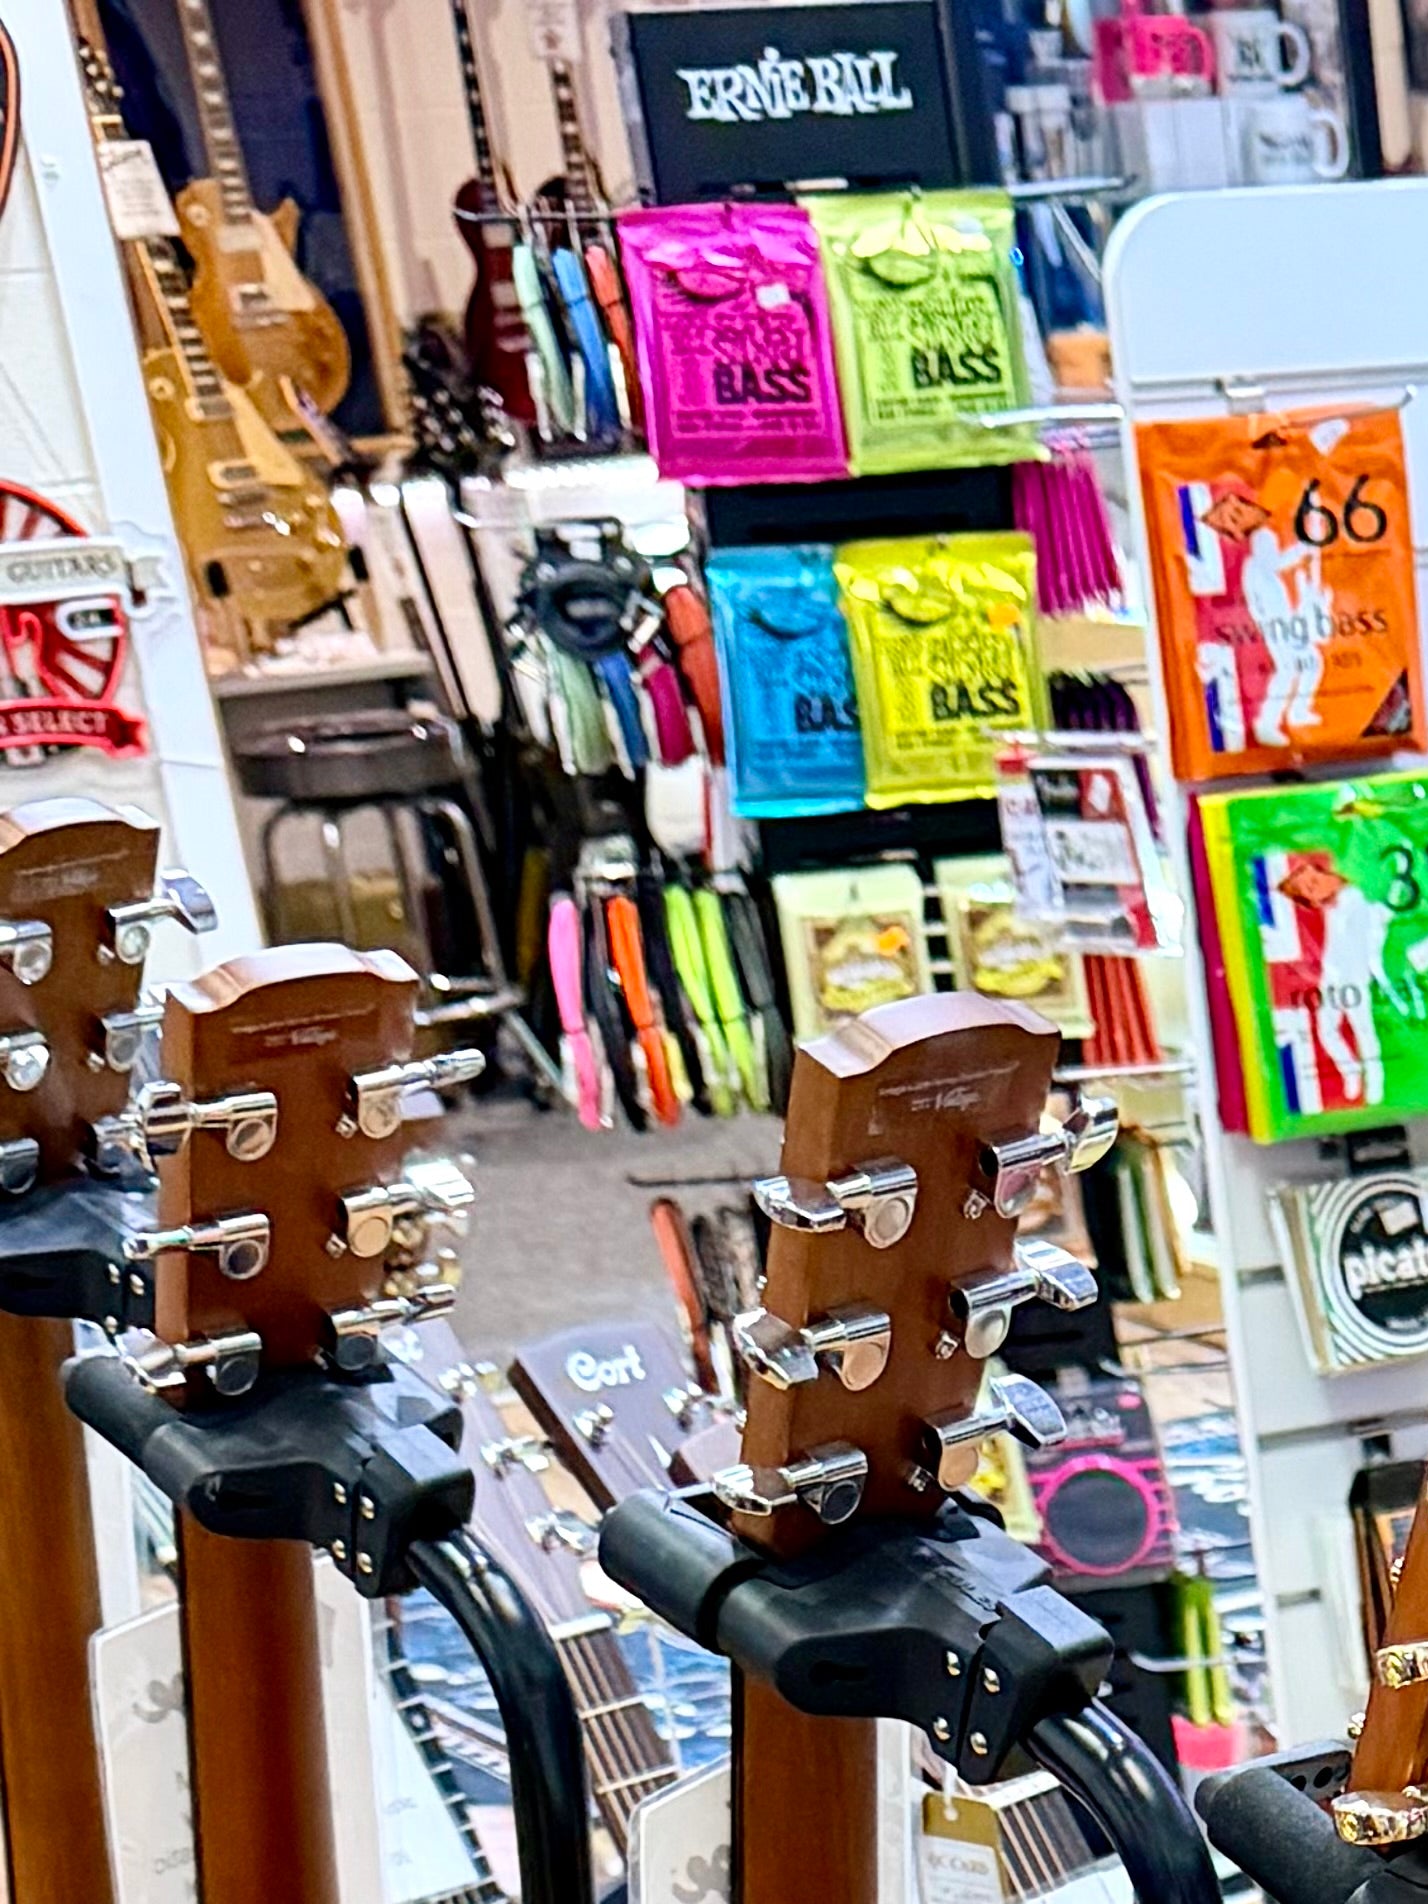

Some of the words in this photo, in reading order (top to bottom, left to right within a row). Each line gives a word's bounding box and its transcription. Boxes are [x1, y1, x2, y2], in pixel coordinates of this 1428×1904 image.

[805, 51, 914, 116] BALL
[713, 363, 812, 404] BASS
[911, 345, 1002, 389] BASS
[1294, 473, 1387, 547] 66
[1313, 602, 1388, 641] bass
[931, 675, 1020, 721] BASS
[566, 1344, 647, 1392] Cort
